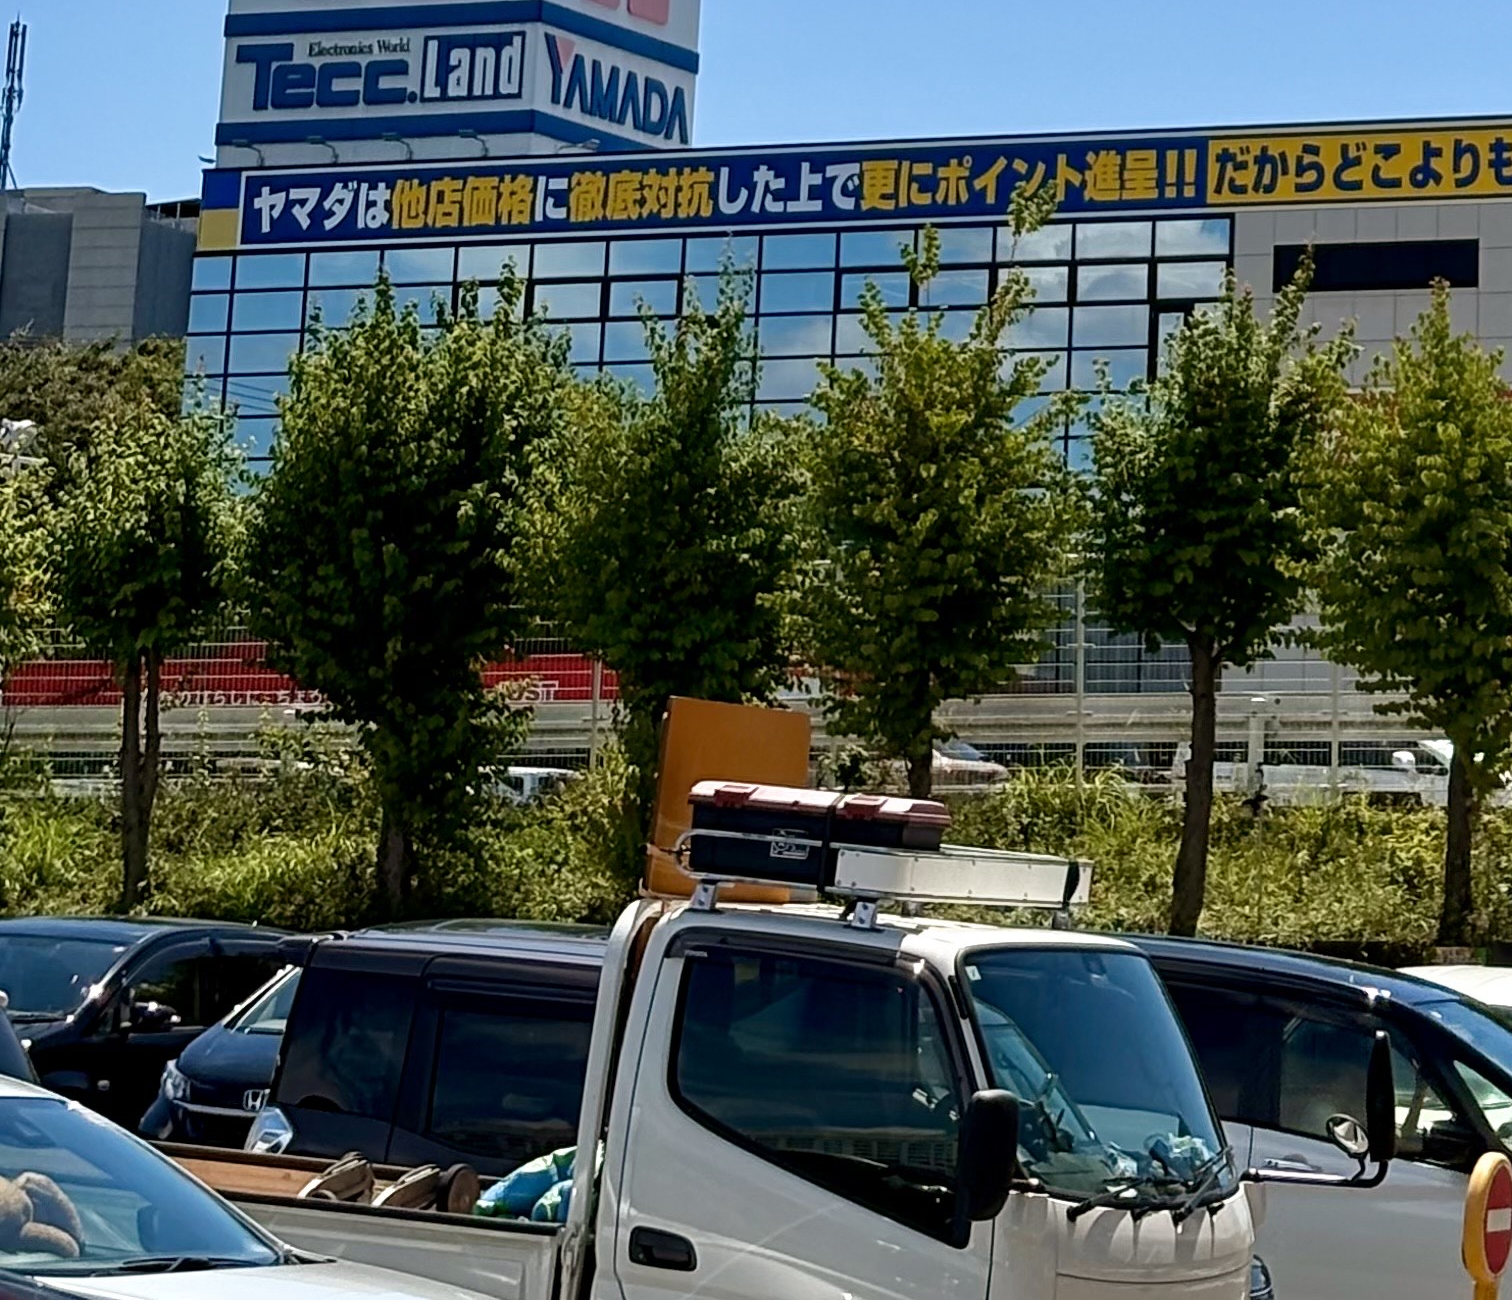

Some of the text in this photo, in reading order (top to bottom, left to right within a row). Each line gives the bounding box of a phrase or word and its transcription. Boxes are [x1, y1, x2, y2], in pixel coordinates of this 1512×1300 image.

[308, 37, 410, 57] Electronics World
[544, 32, 689, 145] YAMADA
